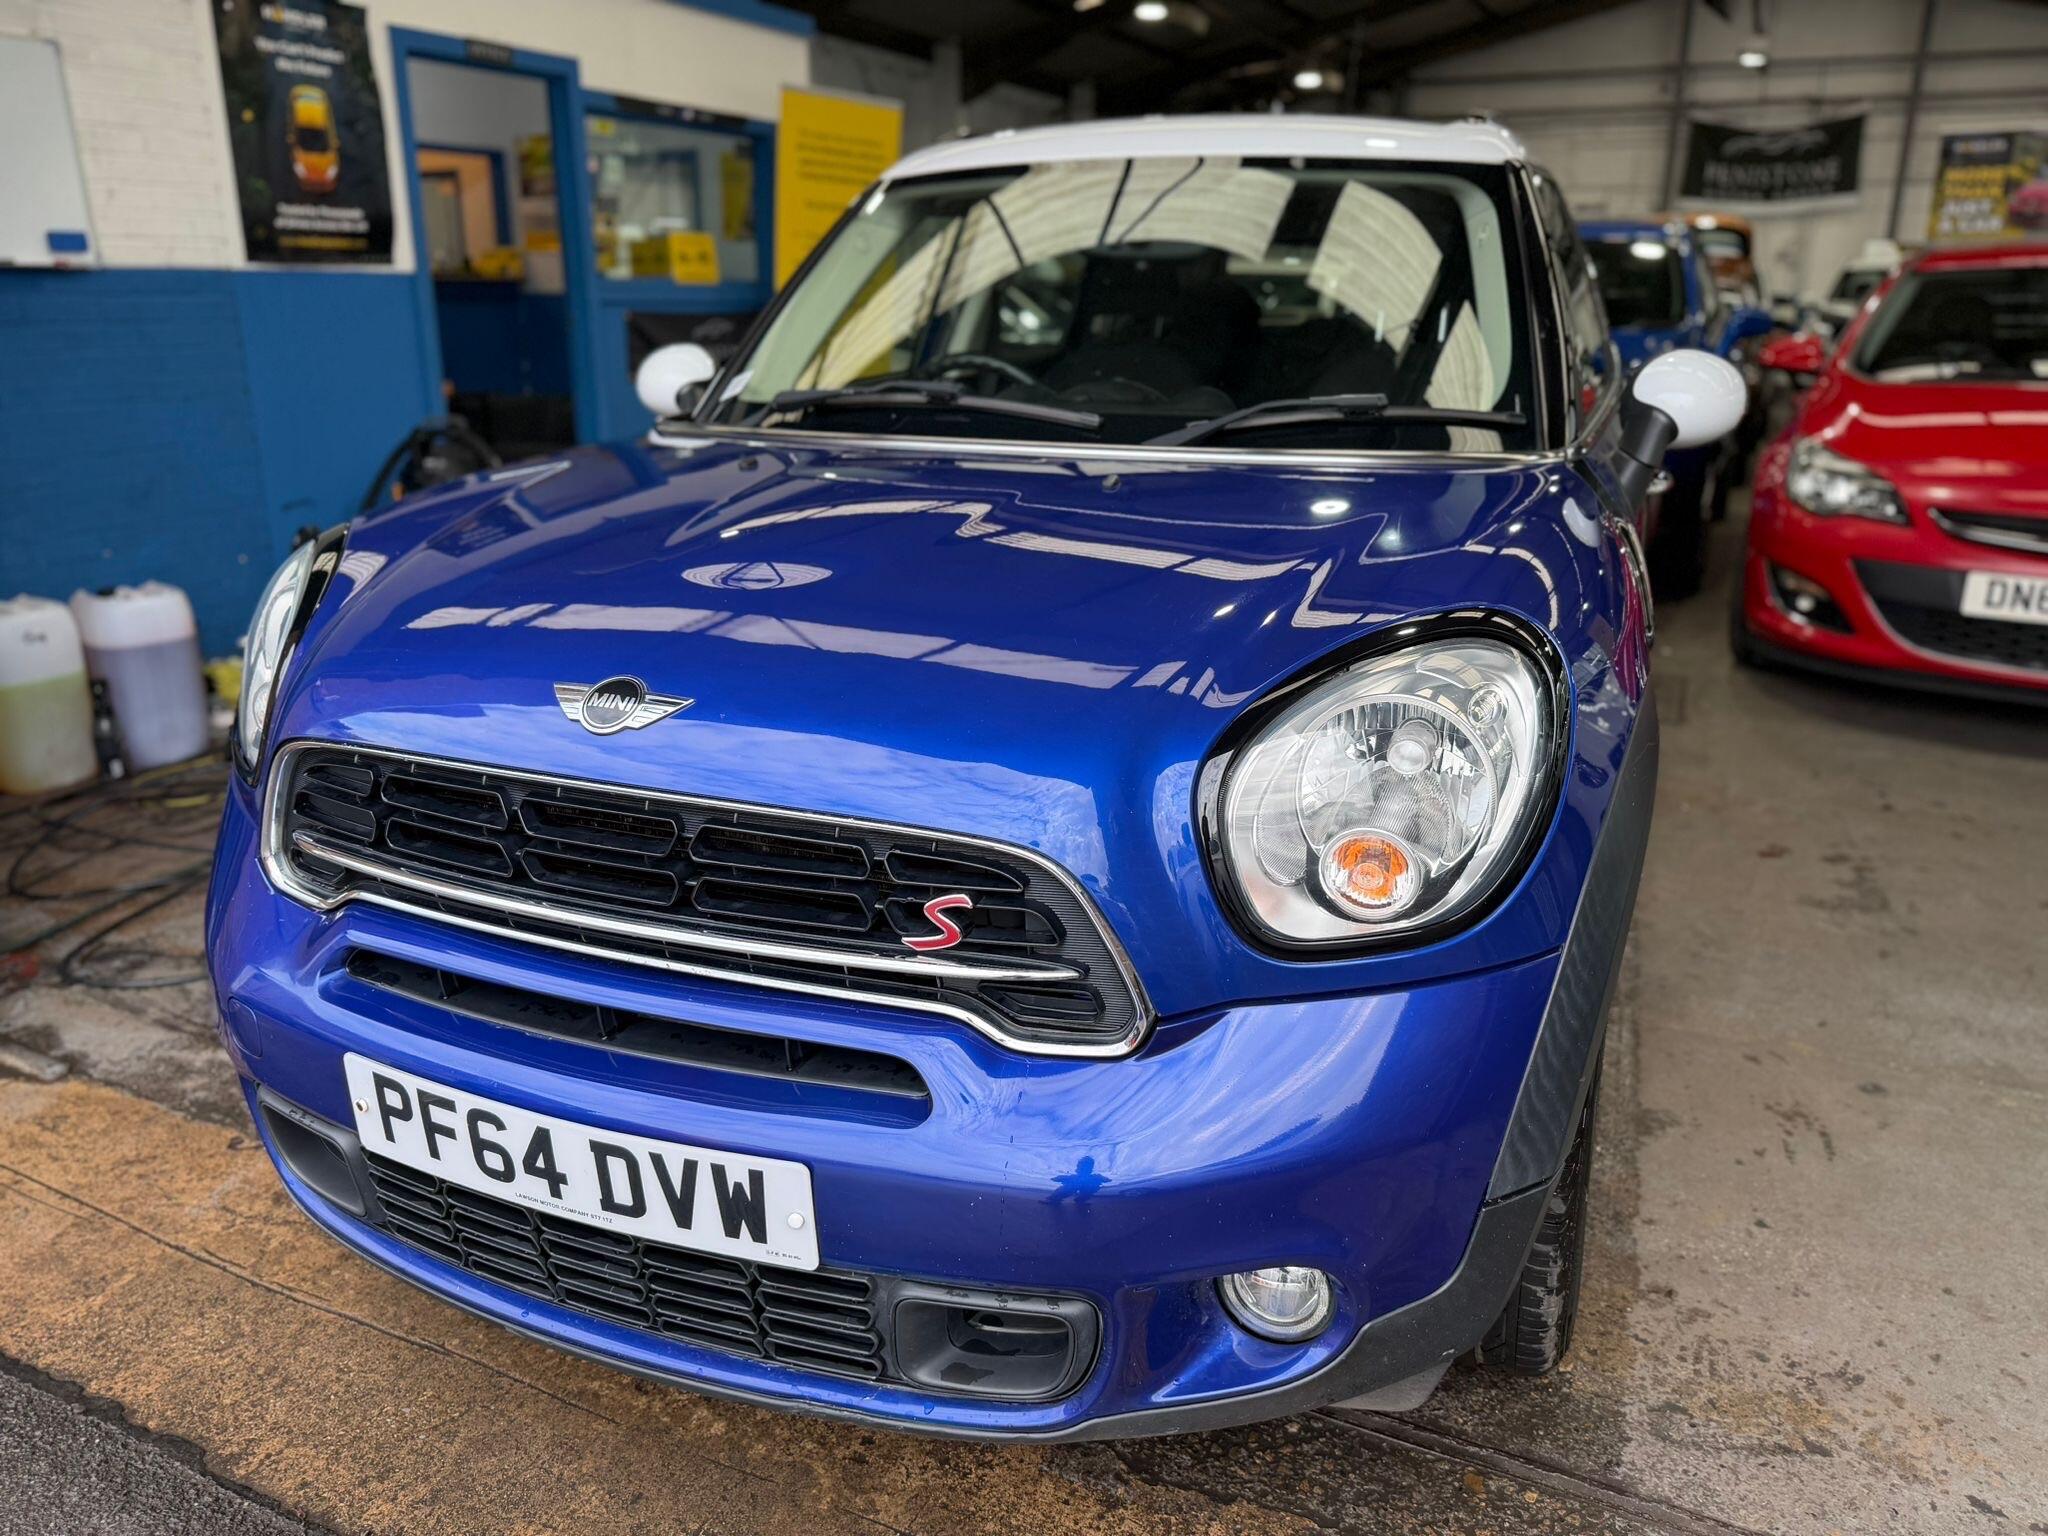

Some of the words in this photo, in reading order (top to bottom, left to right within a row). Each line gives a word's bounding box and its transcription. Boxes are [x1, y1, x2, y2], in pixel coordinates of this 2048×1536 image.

[587, 691, 637, 712] MINI
[901, 894, 973, 951] S
[372, 1071, 568, 1200] PF64
[589, 1138, 769, 1245] DVW
[539, 1199, 560, 1209] MOTOR
[560, 1205, 589, 1217] COMPANY
